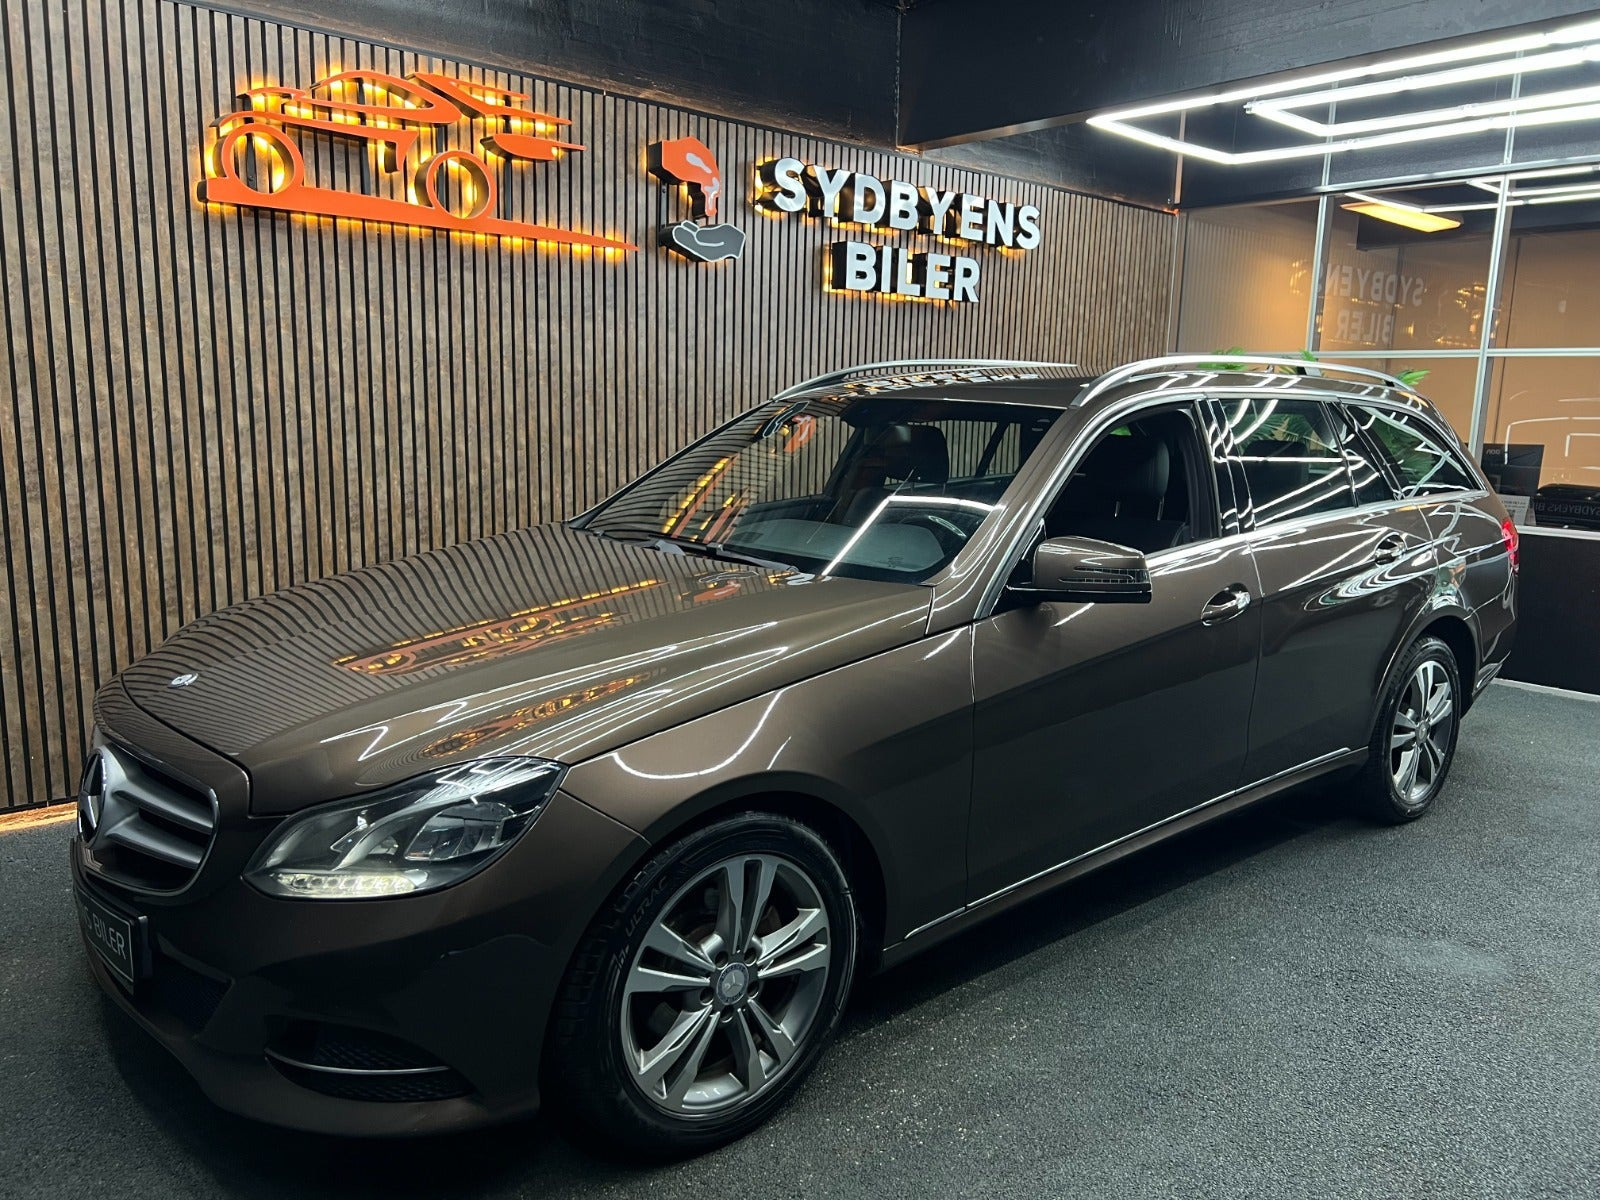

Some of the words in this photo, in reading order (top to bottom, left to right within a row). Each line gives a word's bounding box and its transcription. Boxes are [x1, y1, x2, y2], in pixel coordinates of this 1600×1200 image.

[774, 157, 1041, 250] SYDBYENS
[846, 241, 980, 302] BILER
[92, 912, 127, 961] BILER
